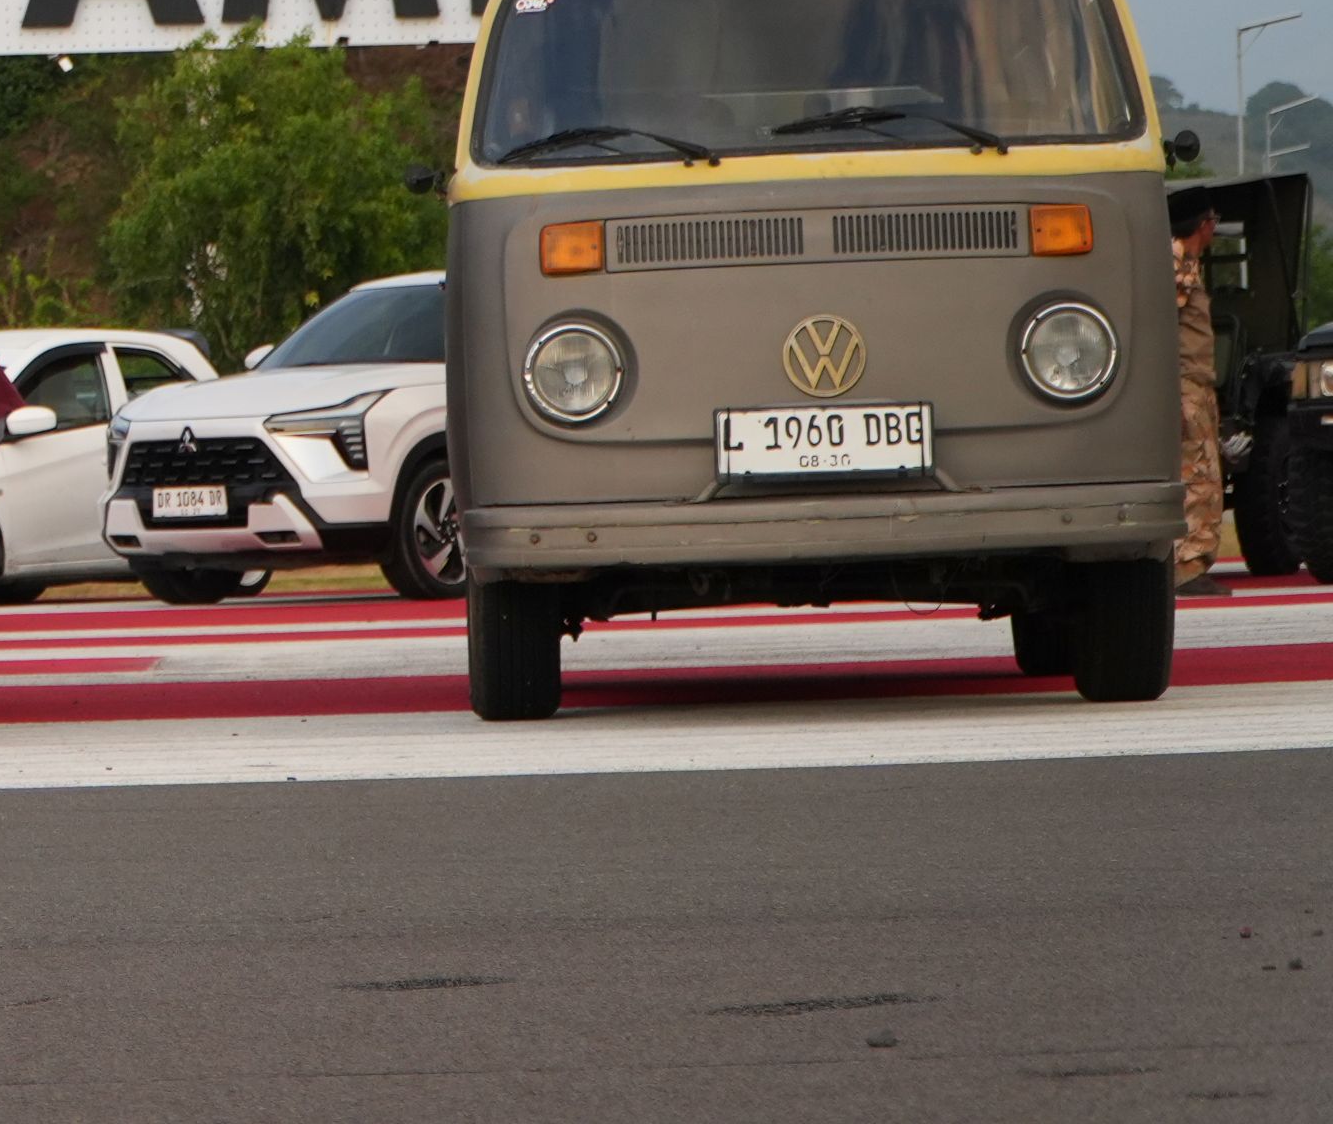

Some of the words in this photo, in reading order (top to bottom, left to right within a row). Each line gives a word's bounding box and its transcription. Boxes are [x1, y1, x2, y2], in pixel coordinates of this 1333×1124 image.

[724, 418, 744, 451] L
[763, 413, 845, 450] 1960
[863, 411, 923, 446] DBG
[158, 492, 171, 508] DR
[176, 491, 204, 508] 1084
[209, 489, 222, 506] DR
